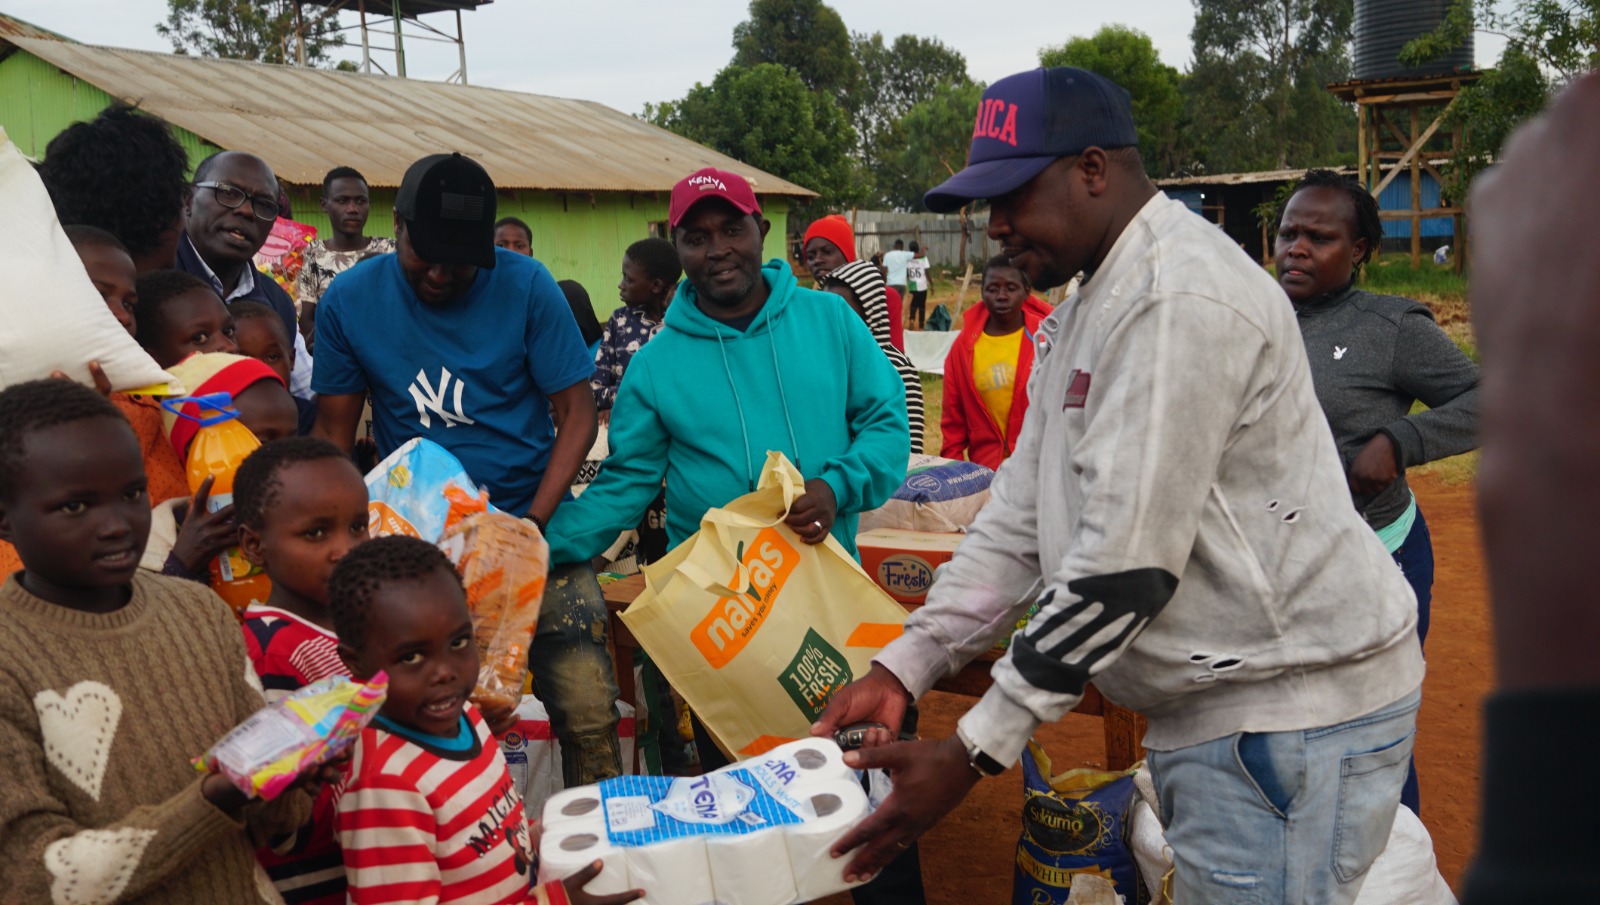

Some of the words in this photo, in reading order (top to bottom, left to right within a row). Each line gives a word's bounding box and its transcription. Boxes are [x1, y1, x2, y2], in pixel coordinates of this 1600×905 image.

[688, 176, 727, 191] KENYA
[408, 366, 475, 429] NY
[882, 561, 928, 588] Fresh
[741, 617, 758, 638] saves
[789, 644, 824, 692] 100%
[801, 656, 842, 707] FRESH
[690, 775, 719, 819] TENA
